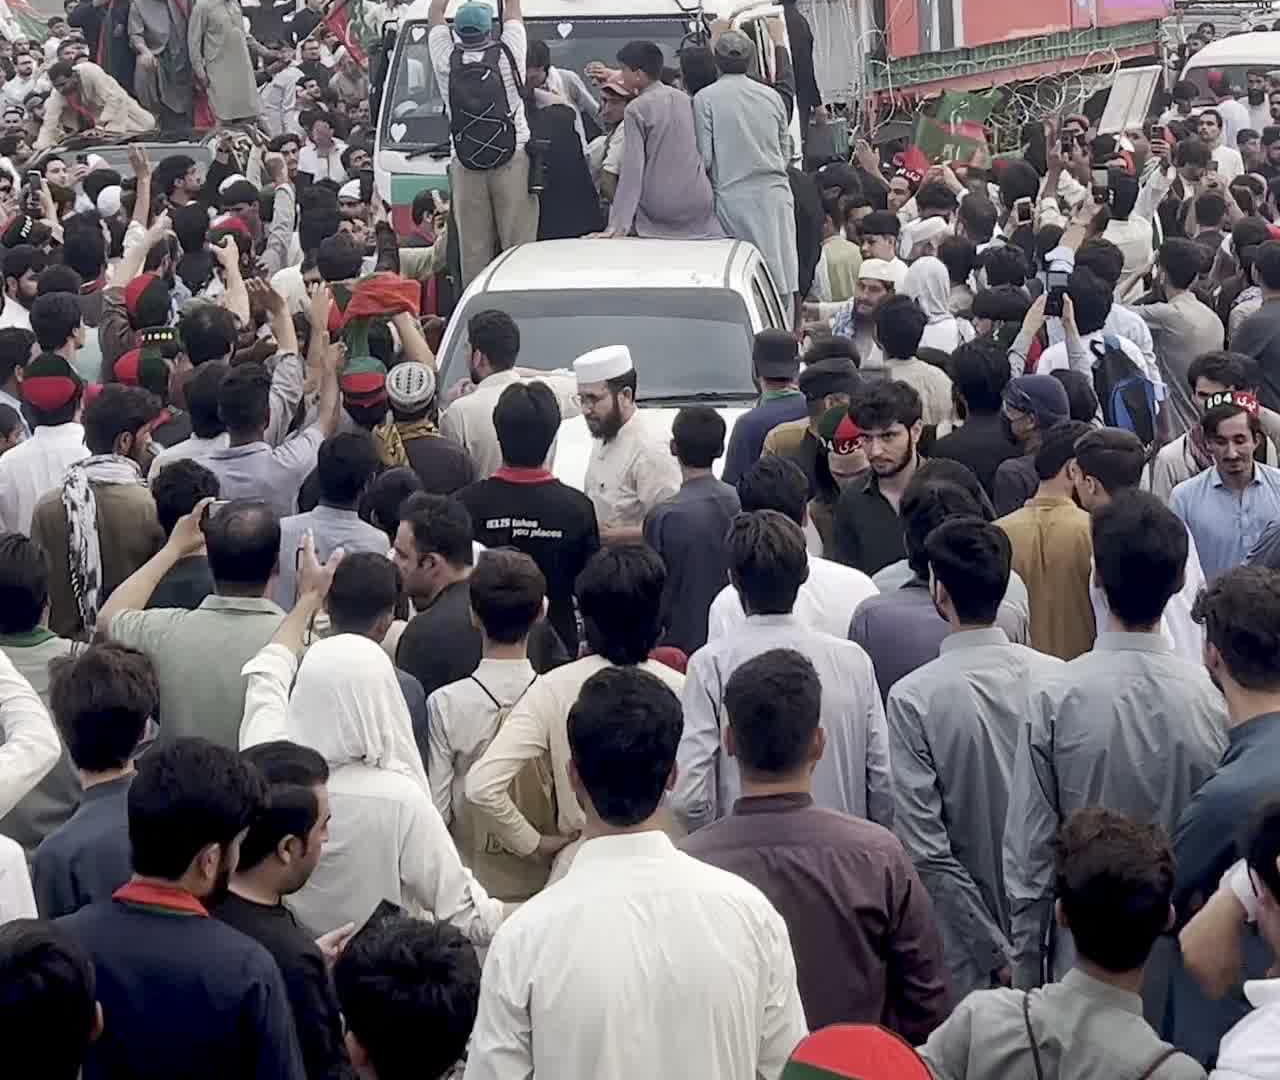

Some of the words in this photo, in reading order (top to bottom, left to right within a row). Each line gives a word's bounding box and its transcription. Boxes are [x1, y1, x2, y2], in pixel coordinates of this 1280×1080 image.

[512, 517, 538, 528] takes
[511, 528, 530, 538] you
[529, 527, 562, 538] places
